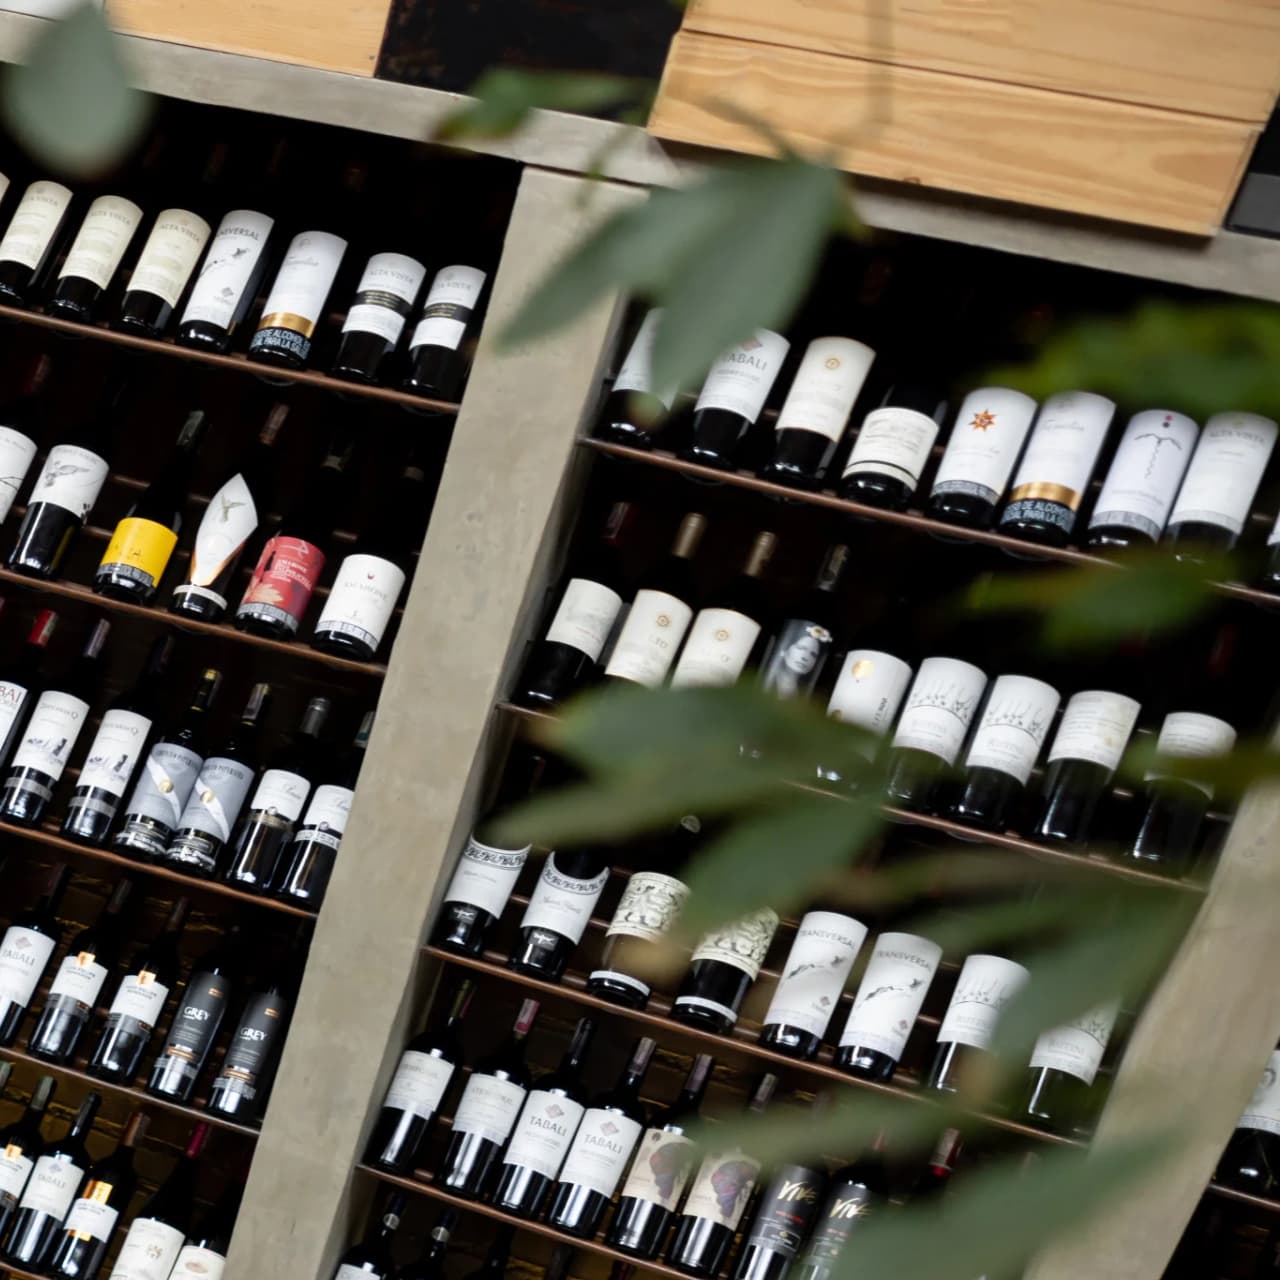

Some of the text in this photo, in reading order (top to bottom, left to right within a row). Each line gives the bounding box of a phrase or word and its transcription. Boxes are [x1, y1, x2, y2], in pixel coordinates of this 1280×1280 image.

[183, 1005, 212, 1022] GREY
[239, 1026, 269, 1042] GREY
[529, 1114, 568, 1138] TABALI
[584, 1133, 624, 1155] TABALI
